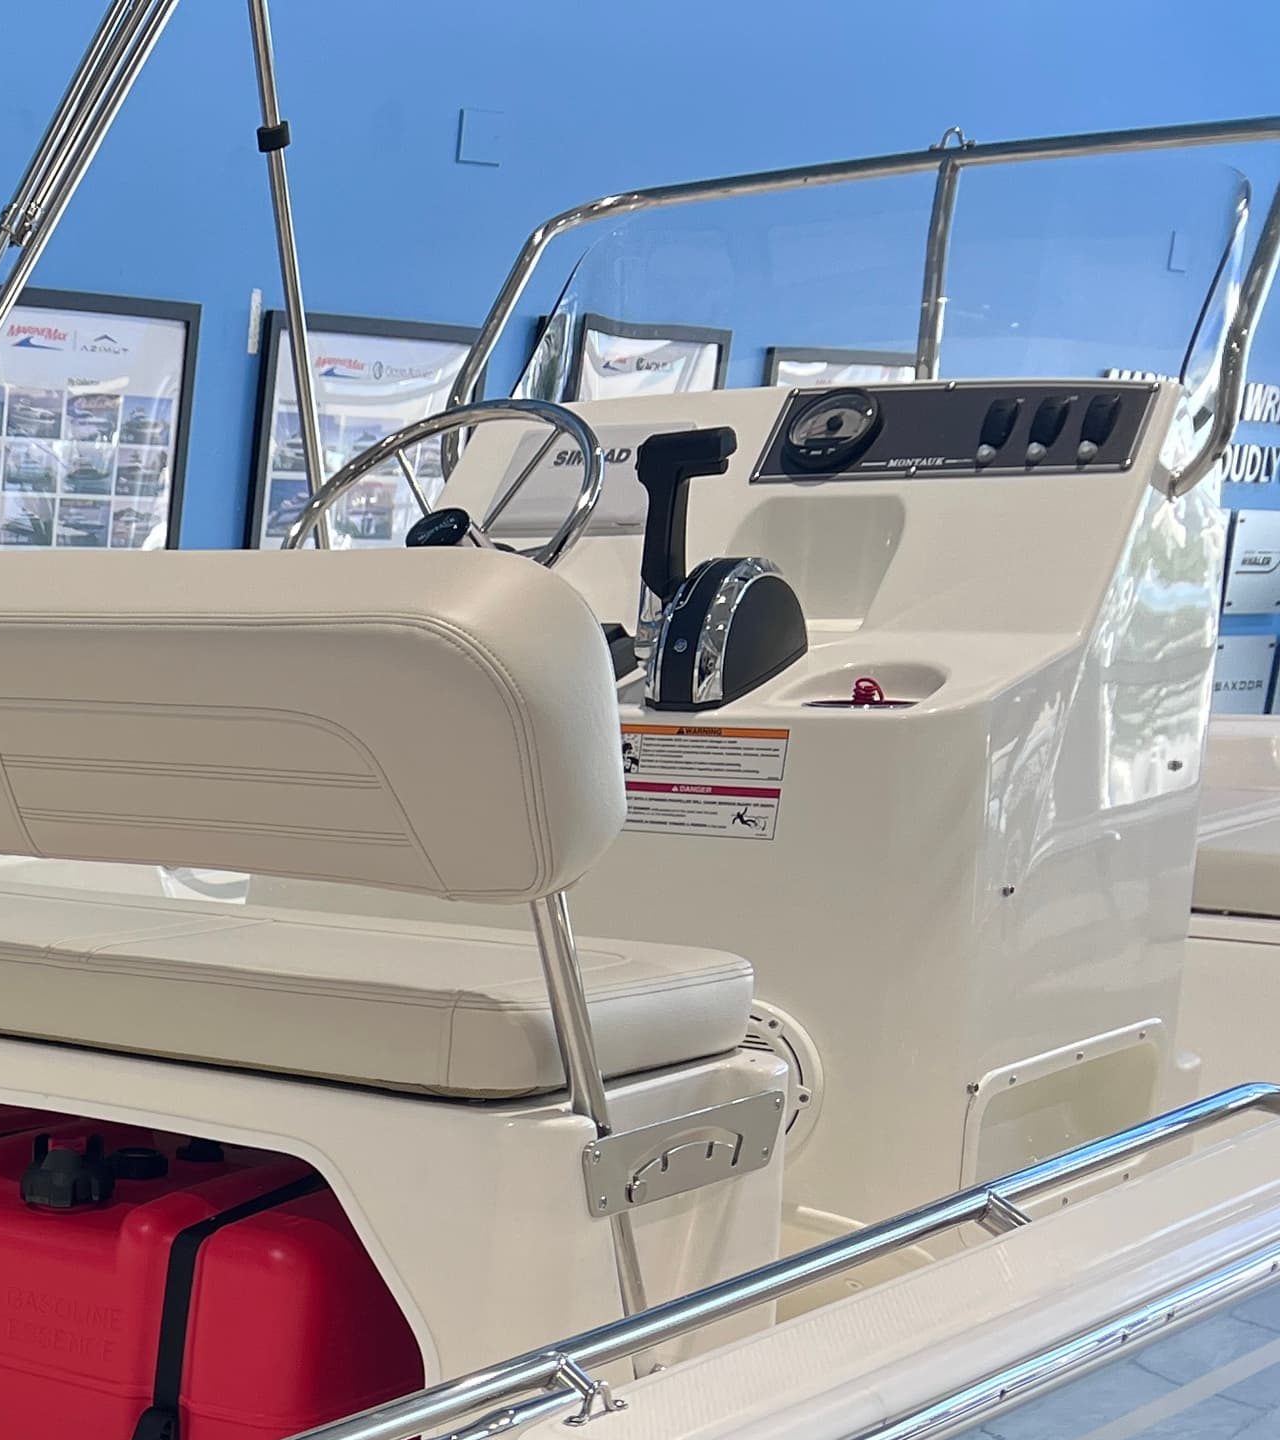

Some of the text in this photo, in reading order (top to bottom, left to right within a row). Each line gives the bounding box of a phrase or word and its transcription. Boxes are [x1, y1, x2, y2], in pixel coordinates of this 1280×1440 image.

[553, 448, 631, 466] SIMAD
[887, 457, 945, 467] MONTAUK
[679, 785, 713, 794] DANGER
